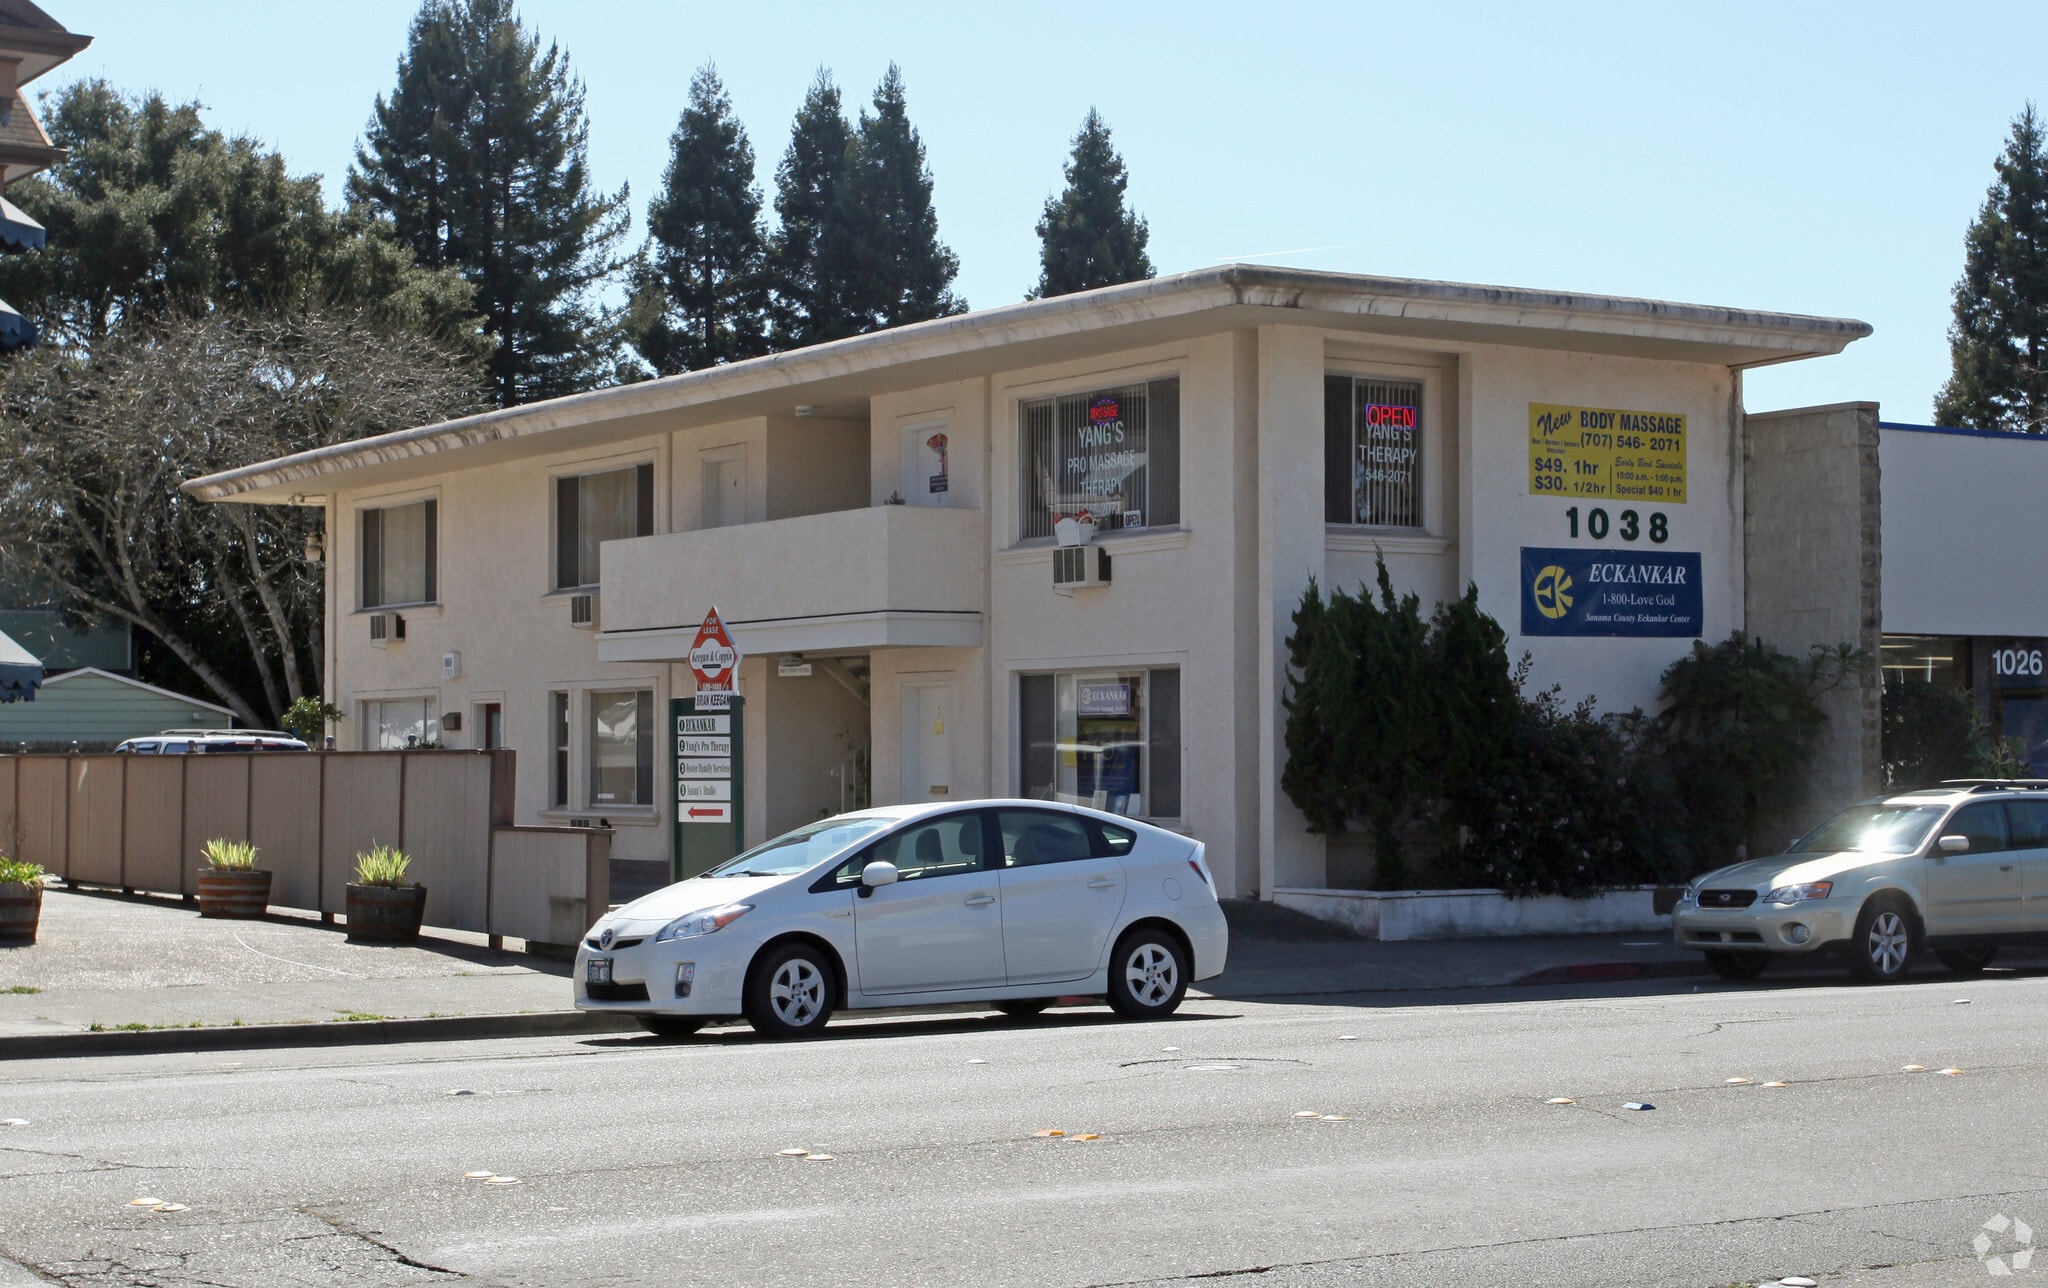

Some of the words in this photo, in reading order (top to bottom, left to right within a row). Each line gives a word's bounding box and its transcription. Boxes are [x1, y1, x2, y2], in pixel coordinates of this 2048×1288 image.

[1090, 404, 1119, 419] MASSAGE
[1369, 406, 1414, 428] OPEN
[1537, 411, 1574, 436] New
[1580, 411, 1615, 429] BODY
[1620, 415, 1681, 434] MASSAGE
[1078, 421, 1124, 448] YANG'S
[1366, 423, 1411, 441] YANG'S
[1581, 432, 1612, 449] (707)
[1617, 436, 1645, 449] 546-
[1650, 439, 1680, 452] 2071
[1068, 456, 1087, 474] PRO
[1090, 450, 1135, 471] MASSAGE
[1359, 445, 1417, 464] THERAPY
[1535, 458, 1567, 474] $49.
[1575, 460, 1598, 475] 1hr
[1615, 456, 1634, 468] Early
[1638, 458, 1653, 468] Bird
[1655, 460, 1683, 470] Specials
[1366, 469, 1411, 483] 546-2071
[1080, 477, 1123, 497] THERAPY
[1535, 476, 1567, 491] $30.
[1574, 482, 1605, 494] 1/2hr
[1616, 485, 1645, 495] Special
[1648, 485, 1663, 496] $40
[1673, 488, 1681, 497] hr
[1125, 513, 1140, 526] OPEN
[1566, 506, 1669, 544] 1038
[1588, 563, 1687, 585] ECKANKAR
[1603, 593, 1653, 606] 1-800-Love
[1657, 595, 1675, 606] God
[1586, 613, 1612, 622] Sonoma
[1613, 614, 1635, 624] County
[1637, 614, 1669, 623] Eckankar
[1670, 615, 1690, 623] Center
[703, 626, 719, 634] LEASE
[692, 651, 708, 665] Keegan
[710, 651, 714, 661] &
[715, 650, 732, 664] Coppin
[1993, 649, 2043, 676] 1026
[696, 694, 709, 707] BRIAN
[710, 694, 730, 706] KEEGAN
[1092, 691, 1127, 701] ECKANKAR
[685, 718, 716, 732] ECKANKAR
[686, 741, 700, 753] Yang's
[711, 741, 729, 753] Therapy
[699, 764, 712, 774] Family
[713, 764, 730, 772] Services
[703, 785, 716, 795] Studio
